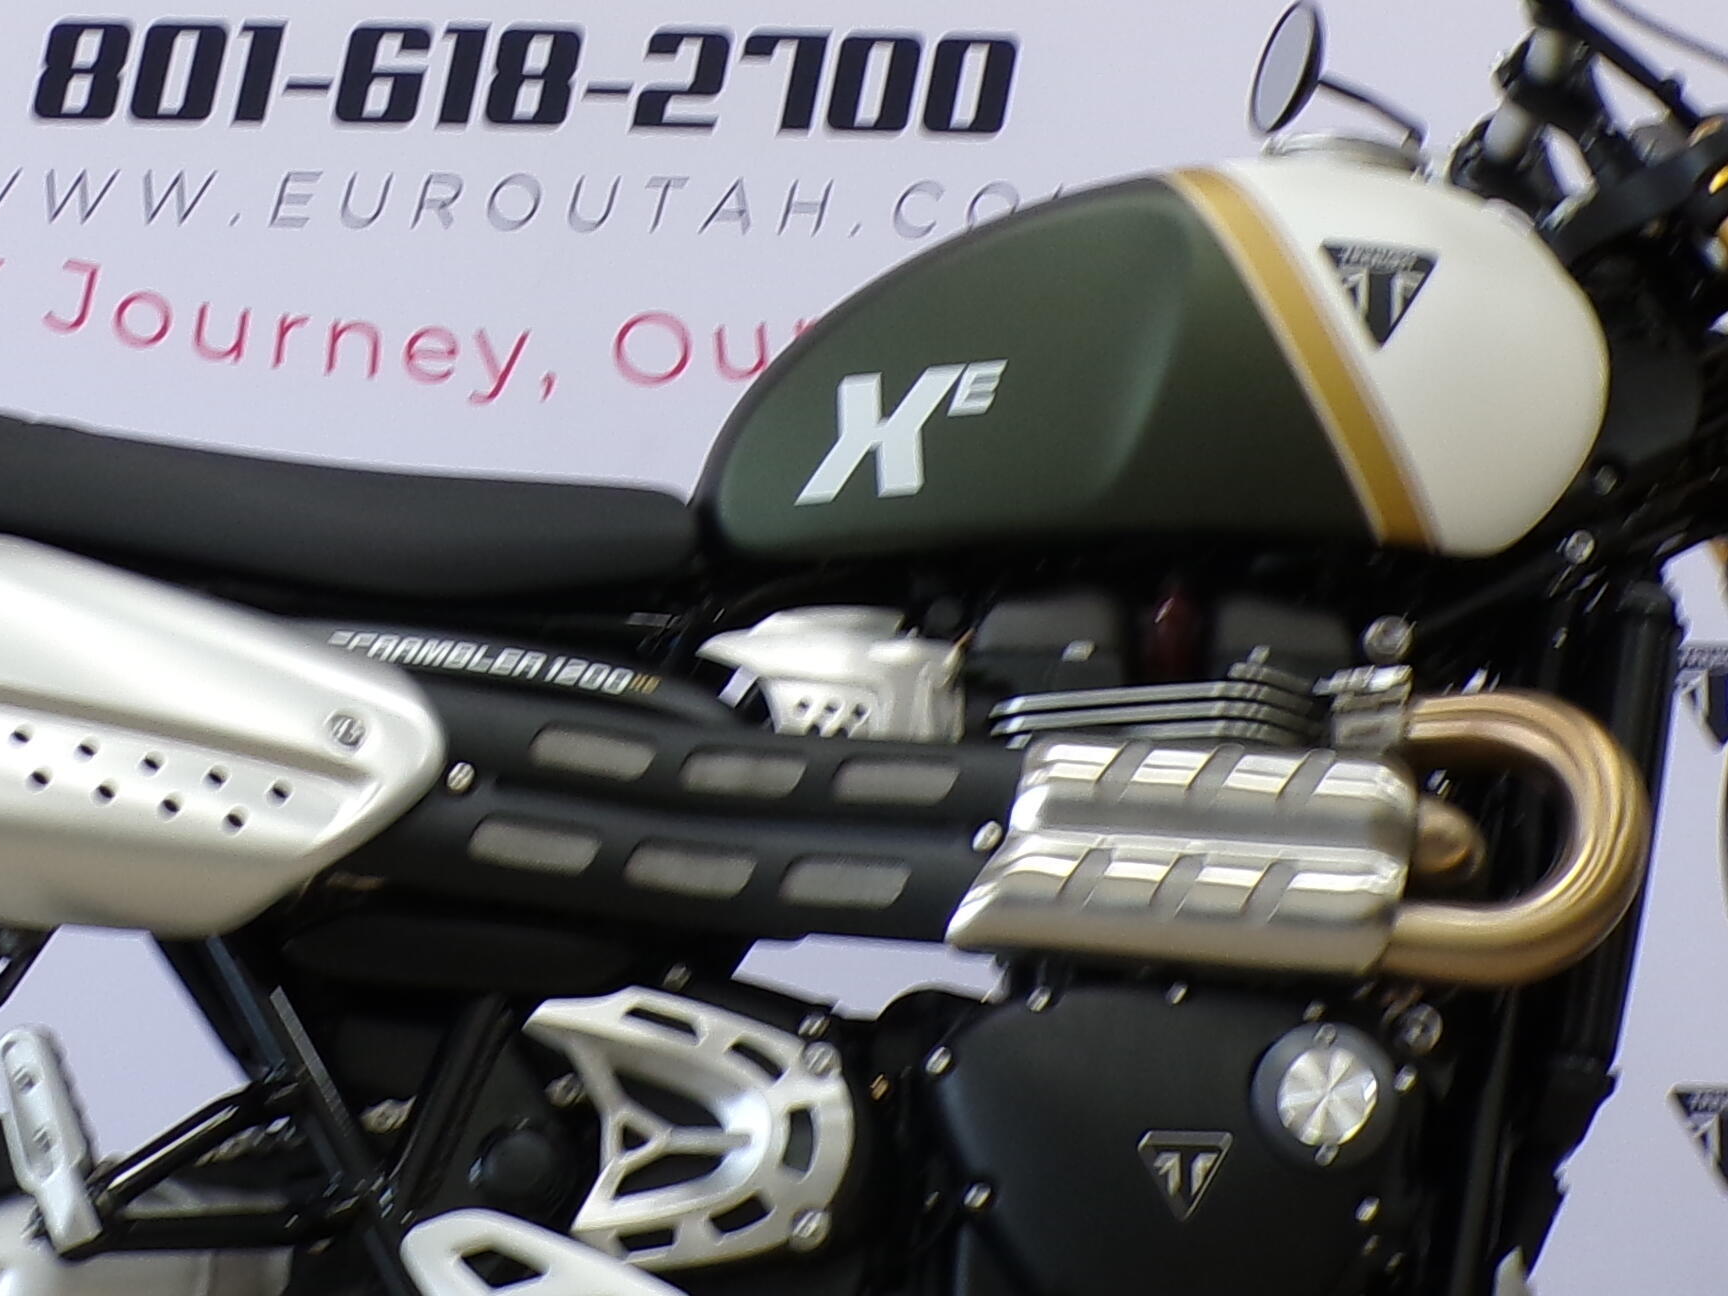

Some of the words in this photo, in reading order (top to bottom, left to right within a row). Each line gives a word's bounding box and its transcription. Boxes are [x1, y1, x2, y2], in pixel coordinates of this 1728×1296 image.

[32, 19, 1019, 138] 801-618-2700
[42, 259, 559, 404] Journey,
[543, 655, 635, 695] 1200
